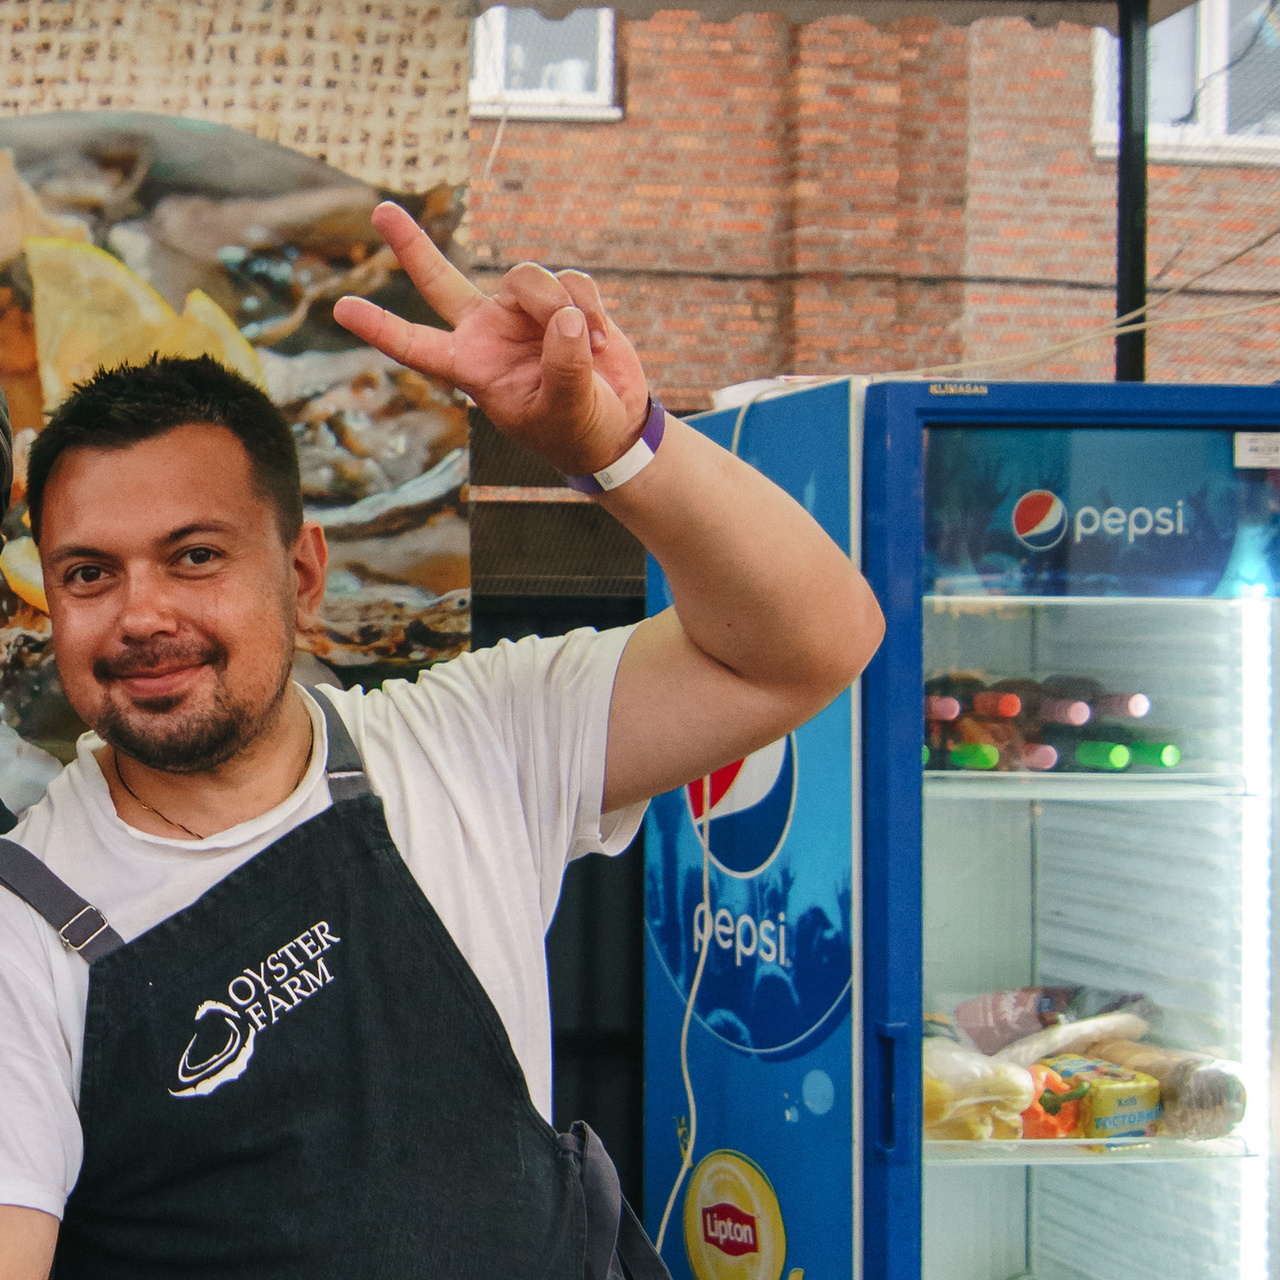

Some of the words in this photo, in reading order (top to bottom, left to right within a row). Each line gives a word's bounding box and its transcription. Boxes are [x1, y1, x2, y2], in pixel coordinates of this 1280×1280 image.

[1073, 499, 1187, 543] pepsi
[228, 920, 341, 1006] OYSTER
[693, 902, 786, 967] pepsi
[244, 957, 335, 1033] FARM
[706, 1212, 754, 1246] Lipton
